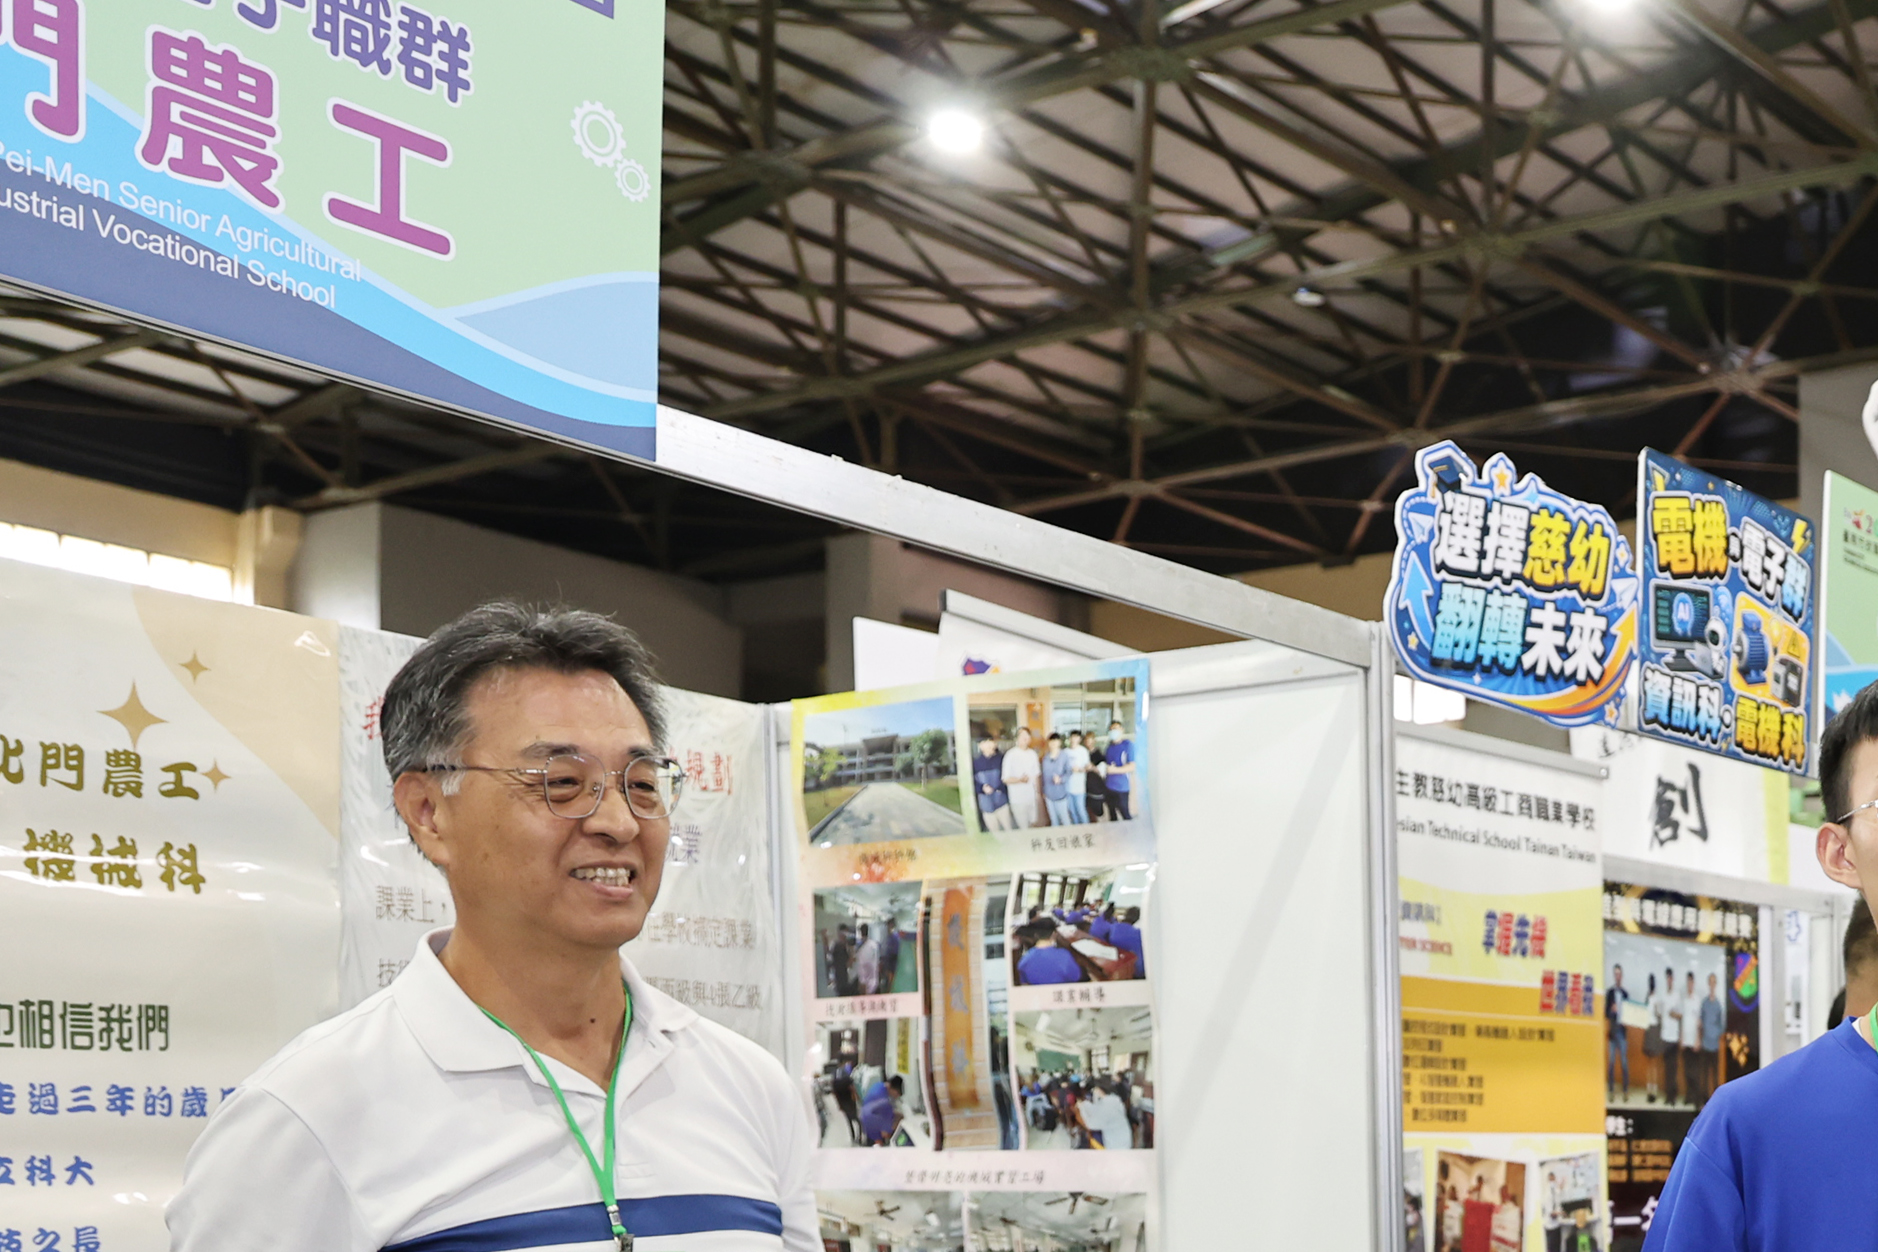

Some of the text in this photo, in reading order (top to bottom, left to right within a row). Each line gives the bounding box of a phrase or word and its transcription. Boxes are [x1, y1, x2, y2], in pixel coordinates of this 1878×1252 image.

[0, 141, 361, 282] ei-Men Senior Agricultural
[92, 208, 239, 279] Vocational
[246, 259, 336, 309] School
[1433, 491, 1611, 599] 選擇慈幼
[1430, 583, 1607, 685] 翻轉未來
[22, 827, 207, 895] 機械科
[1427, 819, 1481, 844] Technical
[1483, 829, 1522, 851] School
[1524, 836, 1560, 858] Tainan
[1562, 843, 1597, 863] Taiwan
[0, 1081, 237, 1118] 走過三年的歲
